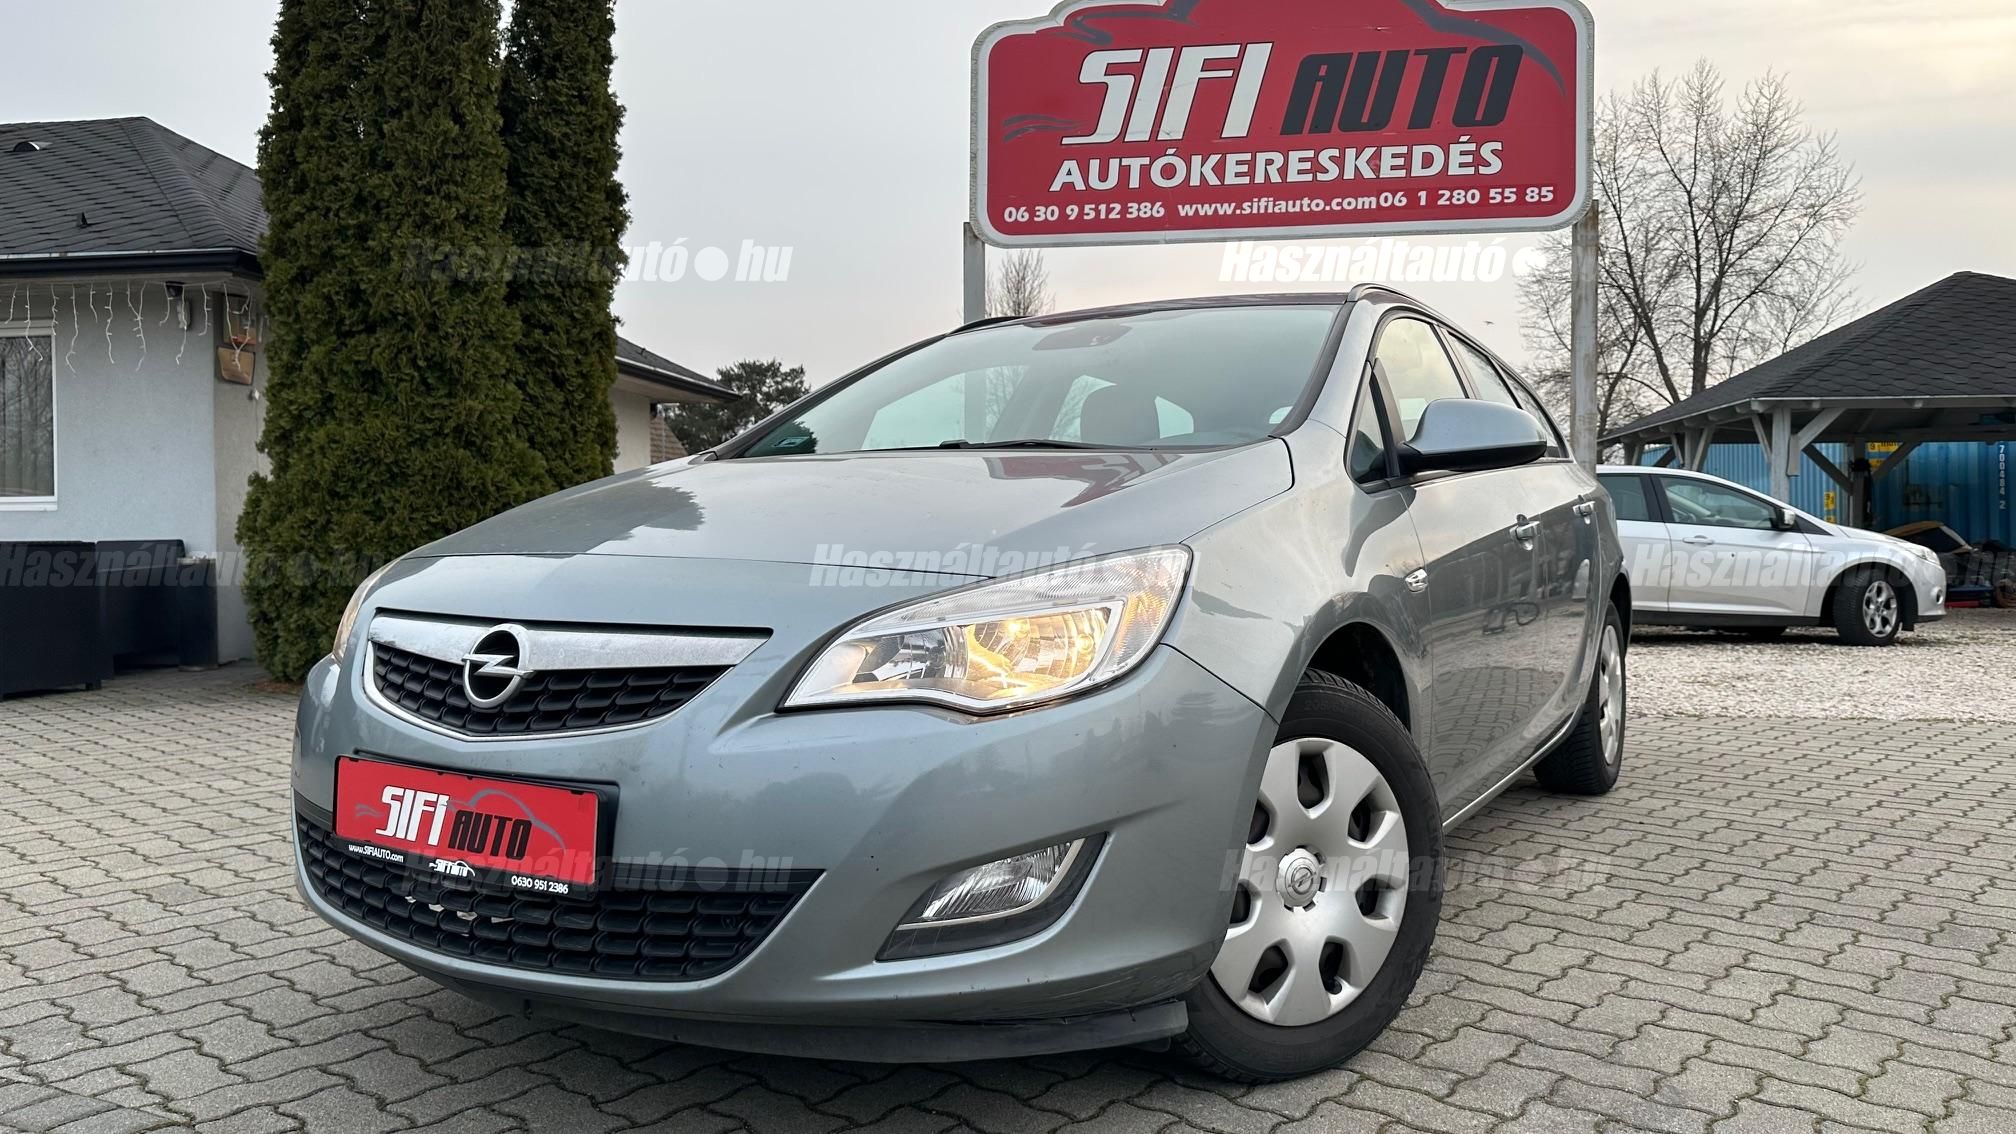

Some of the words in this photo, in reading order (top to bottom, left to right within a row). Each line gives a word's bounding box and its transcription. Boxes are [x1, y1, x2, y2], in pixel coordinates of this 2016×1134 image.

[1060, 41, 1273, 146] SIFI
[1279, 44, 1524, 136] AUTO
[1049, 135, 1503, 193] AUTÓKERESKEDÉS
[1178, 195, 1377, 217] www.sifiauto.com
[1379, 192, 1407, 207] 06
[1418, 190, 1427, 206] 1
[1437, 189, 1480, 205] 280
[1489, 188, 1517, 203] 55
[1525, 187, 1554, 202] 85
[1003, 206, 1029, 222] 06
[1034, 205, 1059, 221] 30
[1065, 205, 1078, 220] 9
[1083, 203, 1121, 219] 512
[1126, 202, 1165, 218] 386
[448, 809, 533, 860] AUTO
[349, 844, 404, 863] www.SIFIAUTO.com
[511, 875, 532, 889] 0630
[534, 879, 547, 891] 951
[548, 881, 569, 894] 2386
